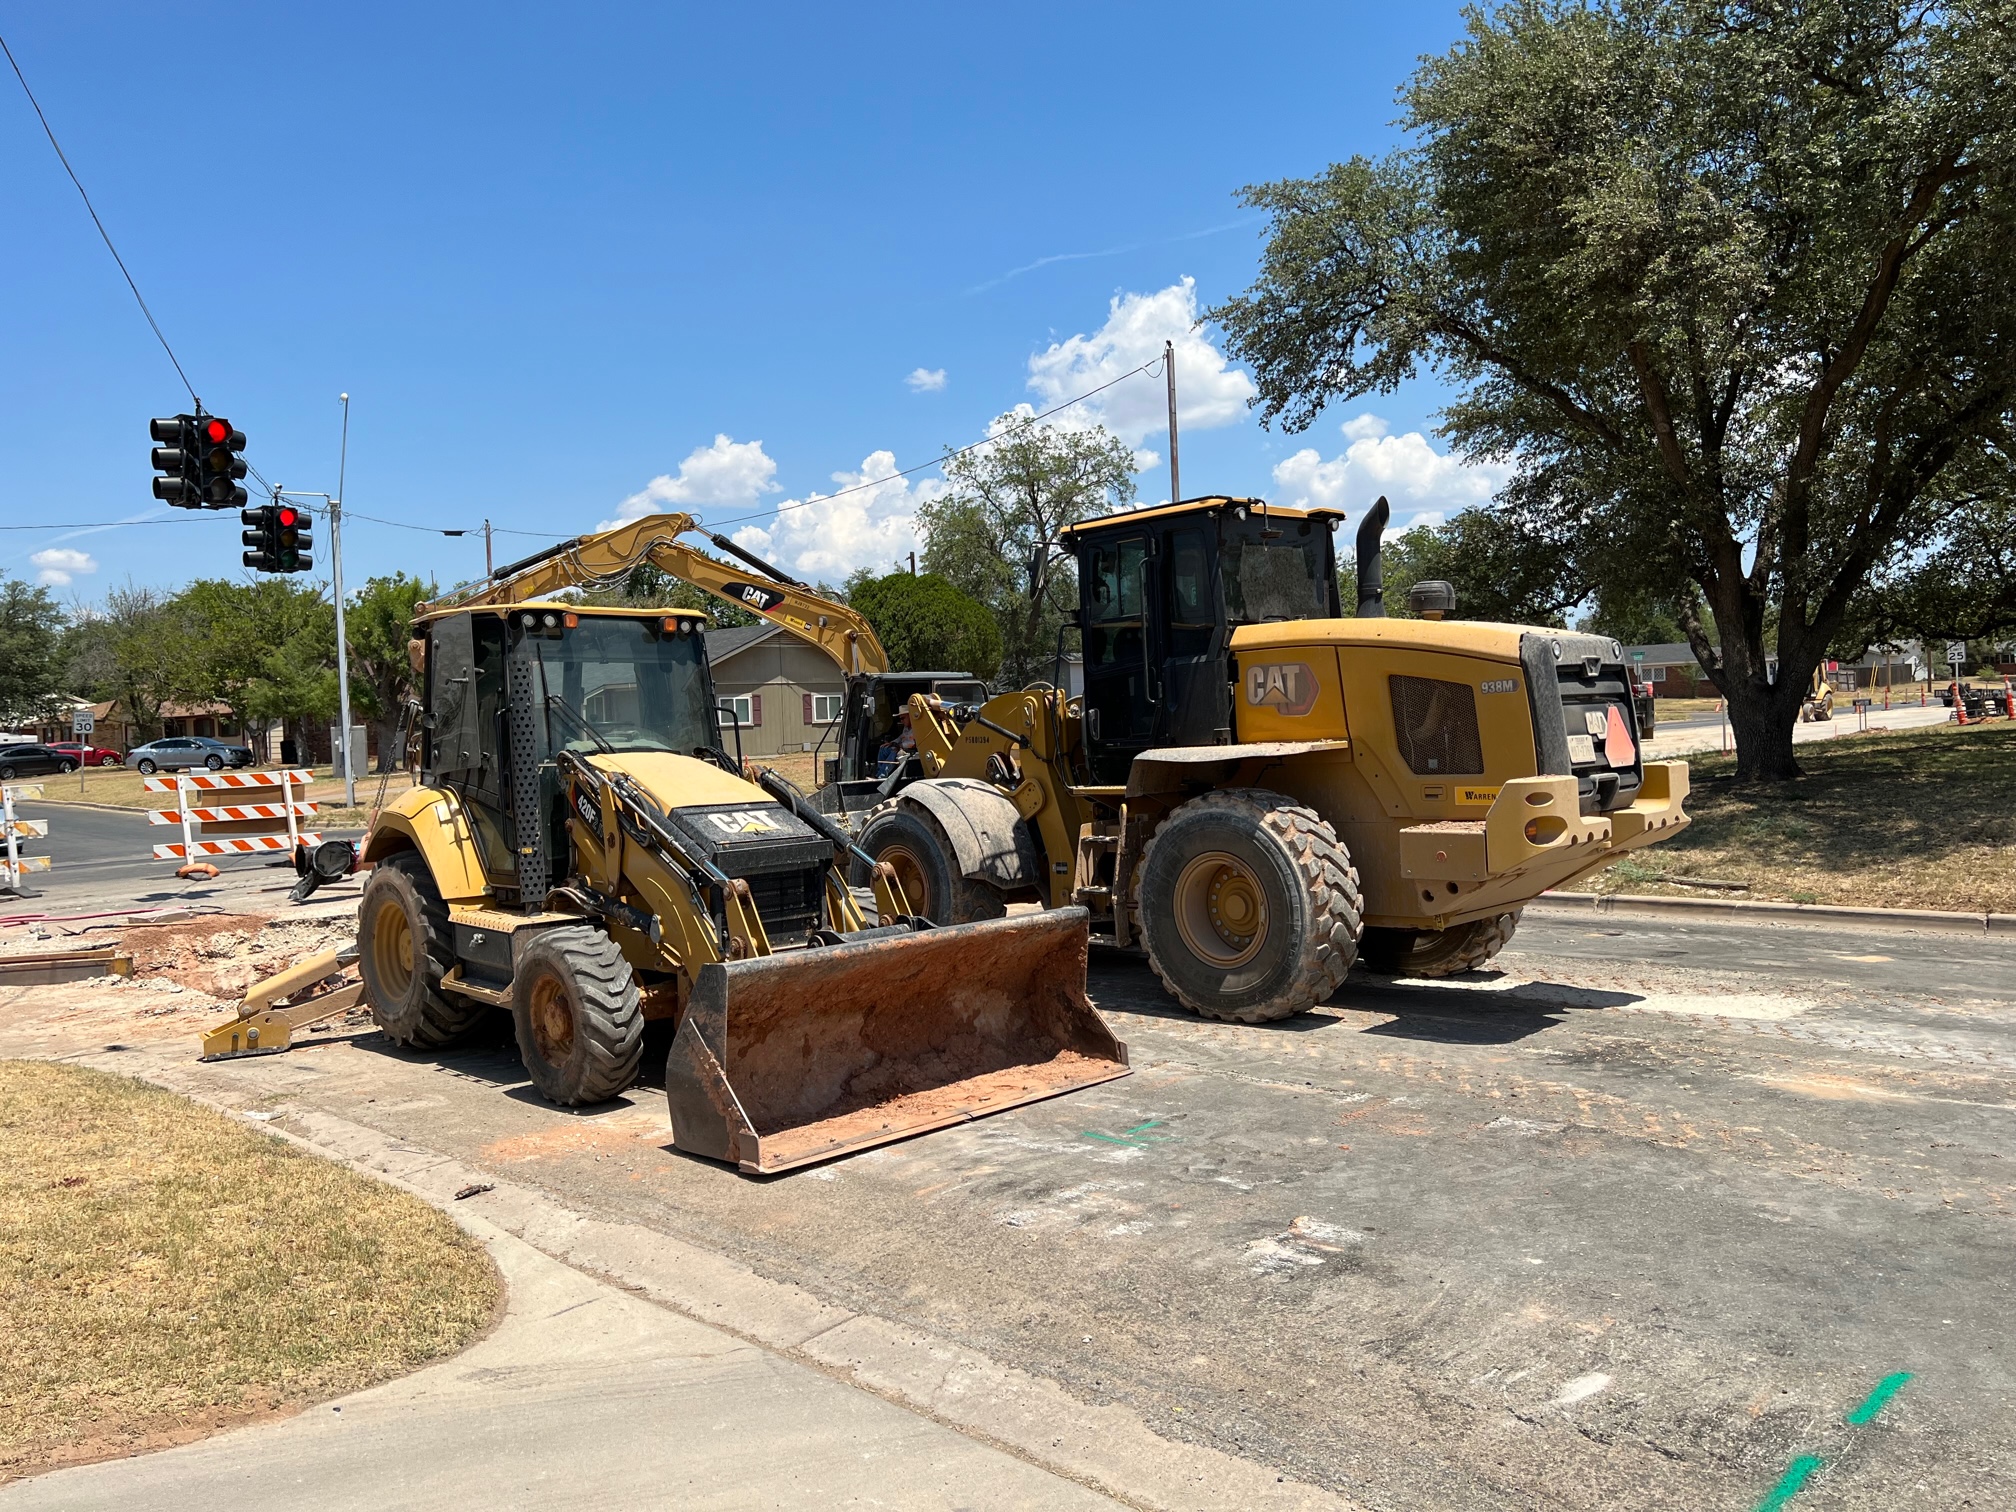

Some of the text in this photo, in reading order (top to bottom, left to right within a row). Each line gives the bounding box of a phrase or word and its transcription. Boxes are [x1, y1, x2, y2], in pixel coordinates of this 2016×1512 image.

[741, 585, 770, 609] CAT
[1949, 652, 1964, 660] 25
[1247, 665, 1300, 704] CAT
[1481, 679, 1513, 694] 938M
[75, 723, 92, 732] 30
[1464, 791, 1497, 800] WARREN
[707, 810, 782, 833] CAT
